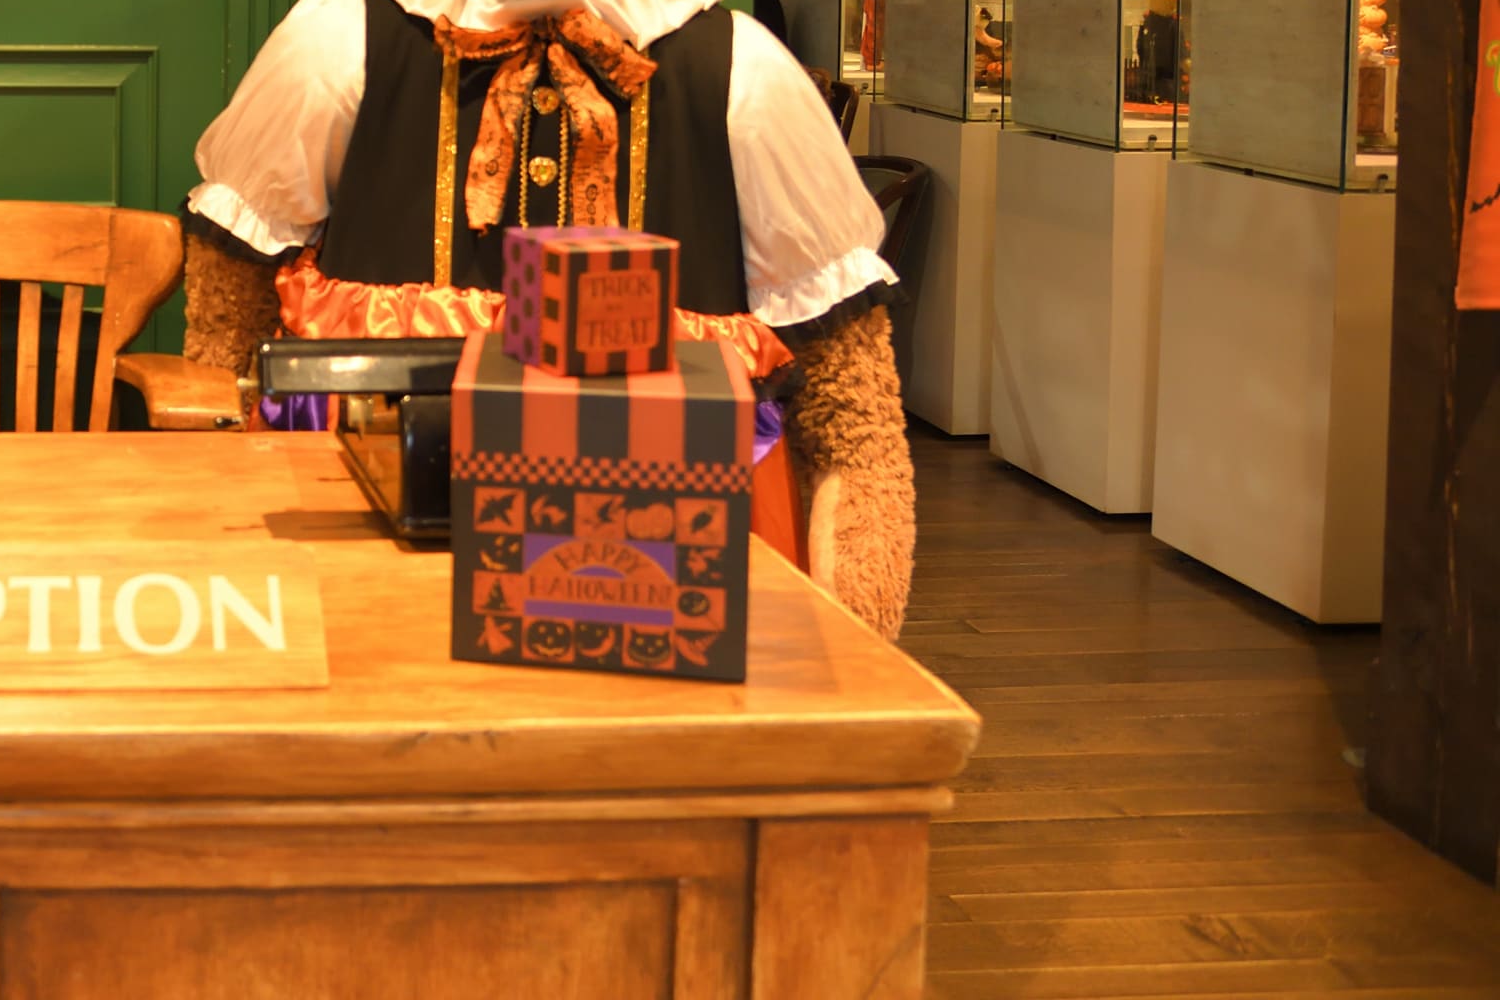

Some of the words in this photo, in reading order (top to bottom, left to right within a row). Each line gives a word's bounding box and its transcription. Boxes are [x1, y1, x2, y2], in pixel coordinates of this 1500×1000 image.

[586, 276, 652, 297] TRICK
[583, 316, 653, 346] TREAT
[553, 541, 649, 575] HAPPY
